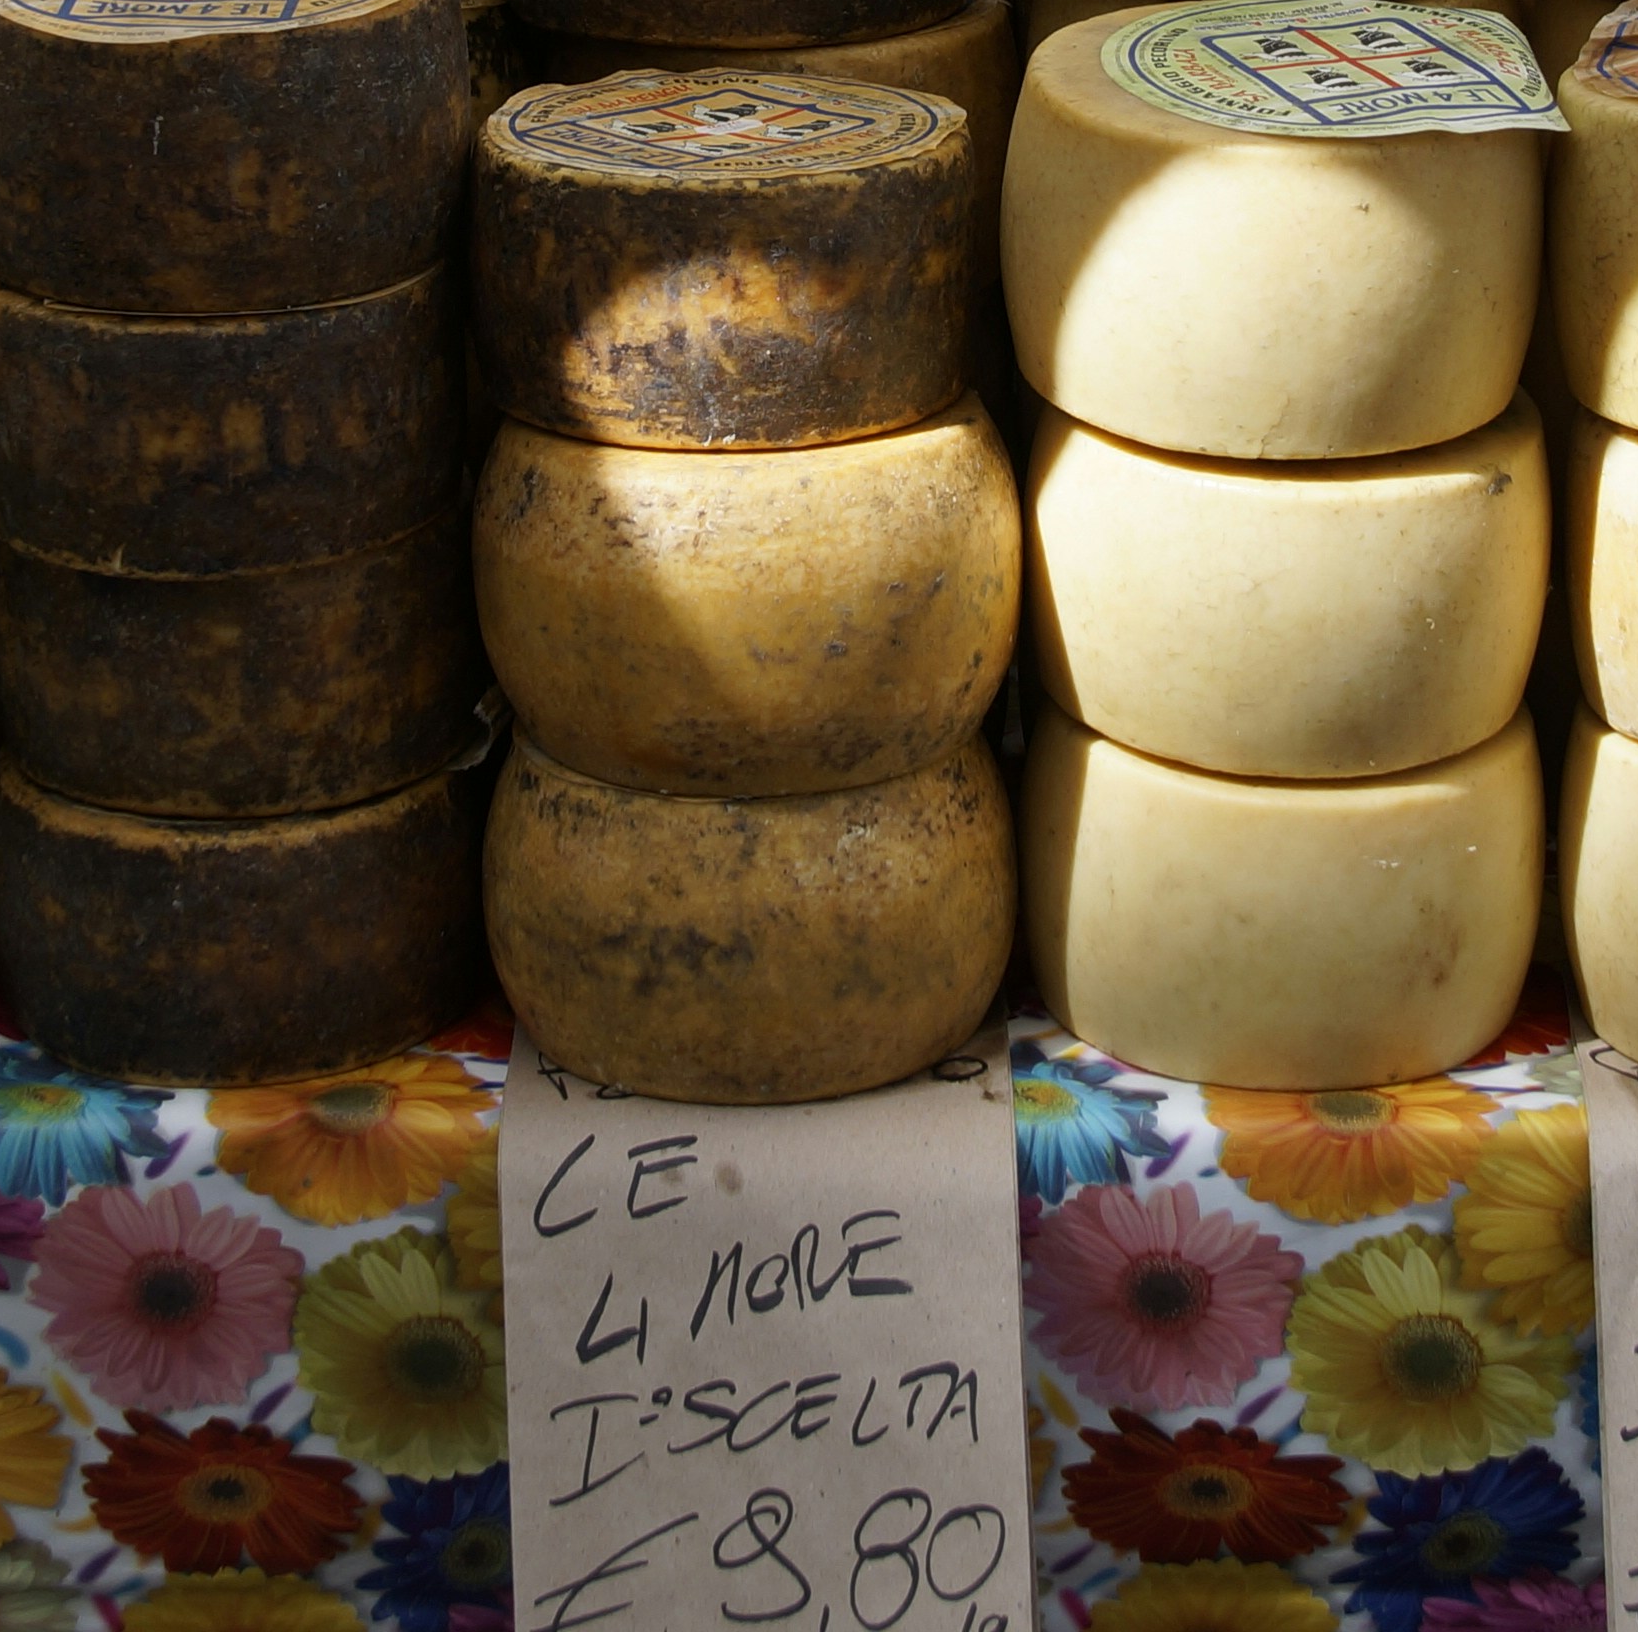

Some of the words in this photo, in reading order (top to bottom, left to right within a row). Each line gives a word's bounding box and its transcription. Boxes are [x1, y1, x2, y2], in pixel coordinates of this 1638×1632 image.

[87, 0, 189, 15] MORE
[199, 3, 220, 16] 4
[230, 3, 271, 15] LE
[1149, 27, 1188, 68] PECORINO
[1164, 71, 1292, 117] FORMAGGIO
[1235, 90, 1268, 103] SA
[1329, 92, 1425, 117] MORE
[1432, 90, 1454, 103] 4
[1465, 88, 1504, 103] LE
[540, 128, 623, 149] MORE
[534, 1134, 698, 1237] LE
[691, 1209, 914, 1341] MORE
[667, 1361, 980, 1455] SCELTA
